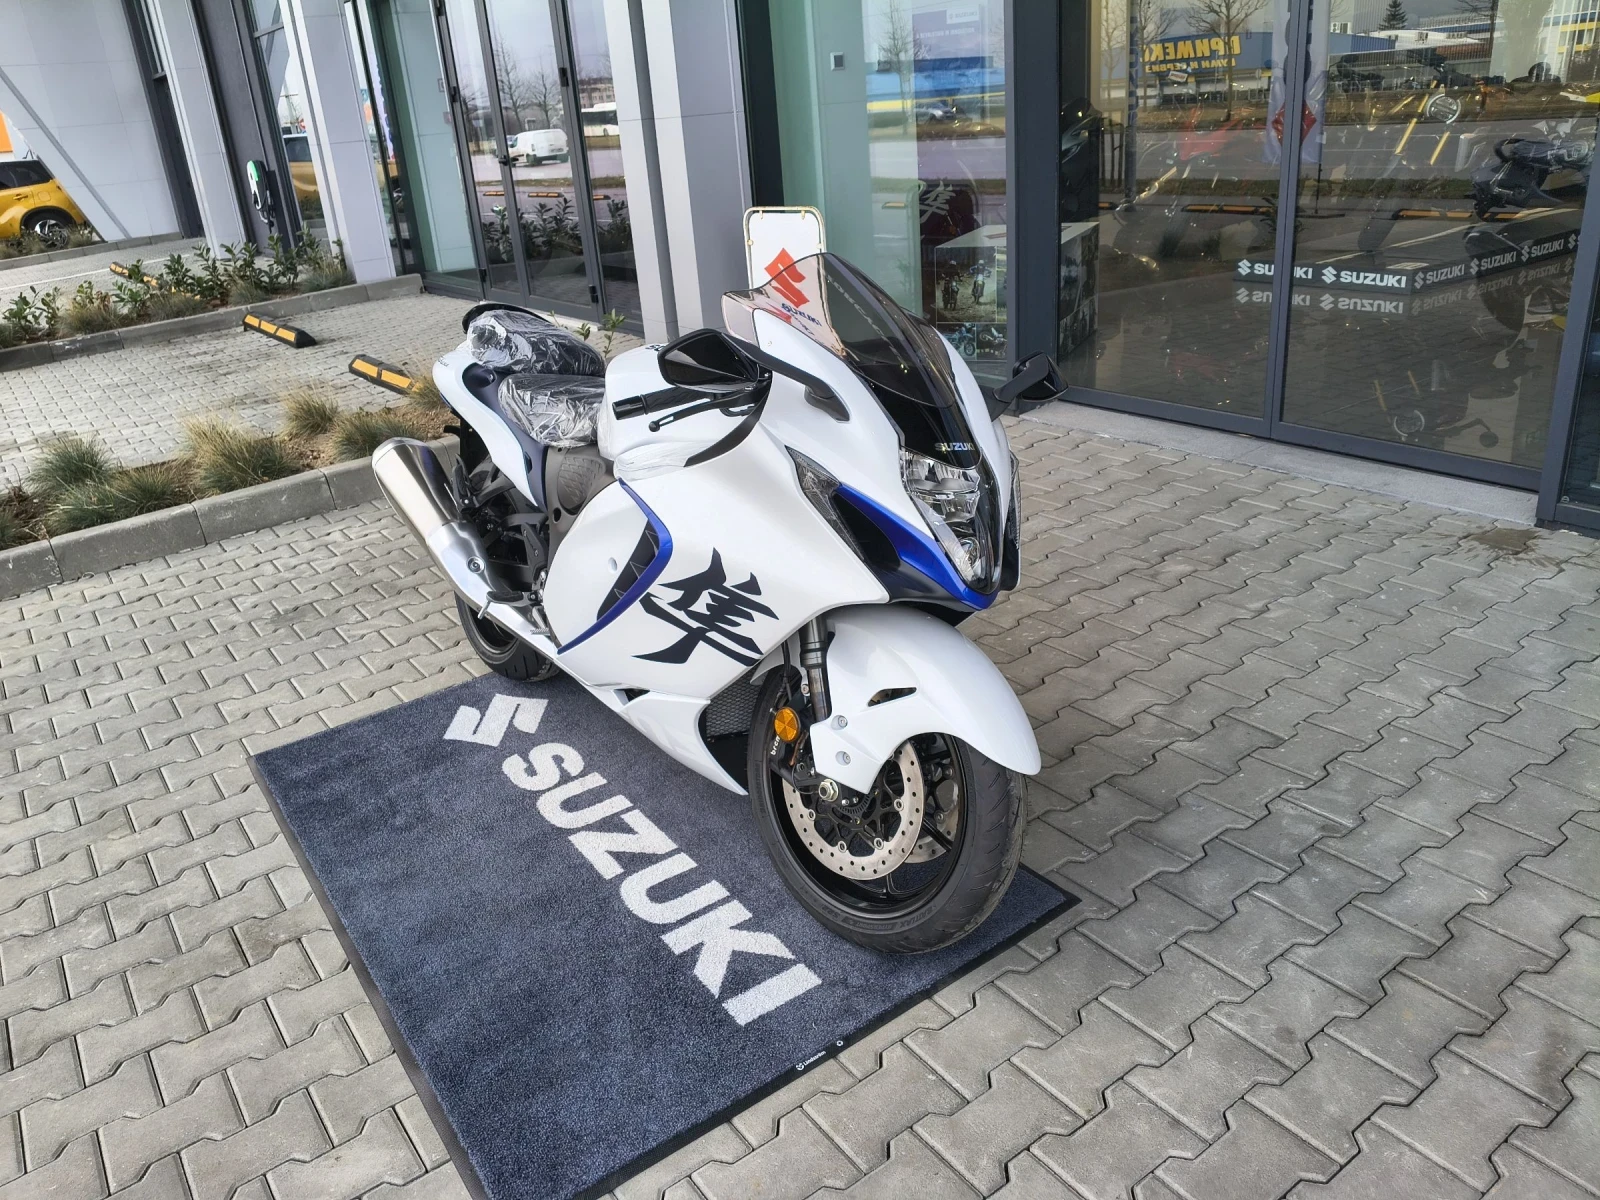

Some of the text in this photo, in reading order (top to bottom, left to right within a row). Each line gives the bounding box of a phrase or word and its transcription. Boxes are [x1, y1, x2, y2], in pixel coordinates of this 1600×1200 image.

[1531, 239, 1564, 258] SUZUKI
[1480, 251, 1517, 270] SUZUKI
[1253, 263, 1313, 279] SUKI
[1340, 271, 1407, 288] SUZUKI
[1425, 264, 1465, 285] SUZUKI
[934, 442, 976, 451] SUZUKI
[630, 546, 780, 667] 隼
[501, 742, 823, 1027] SUZUKI
